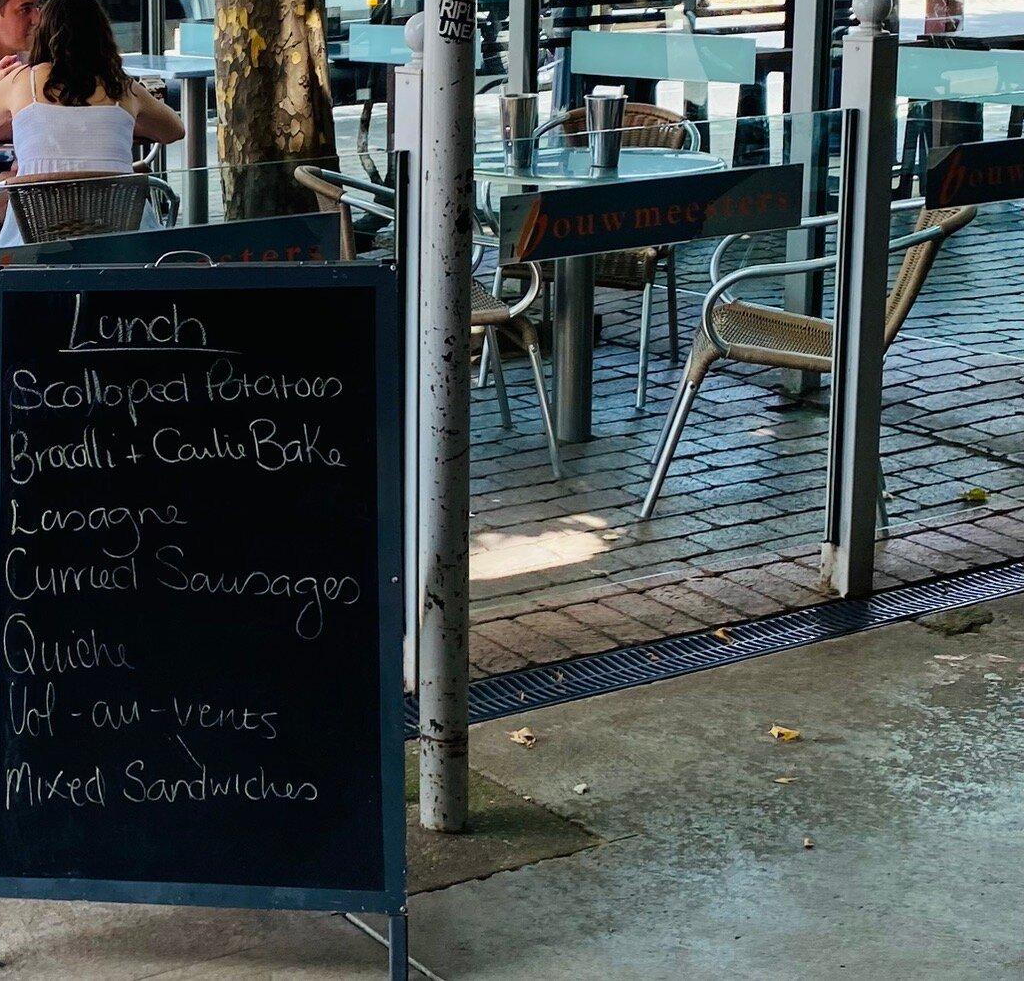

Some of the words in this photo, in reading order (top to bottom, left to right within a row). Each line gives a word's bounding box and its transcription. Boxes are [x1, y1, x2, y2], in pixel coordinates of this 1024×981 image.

[68, 292, 207, 350] Lunch
[125, 443, 144, 464] +
[248, 417, 348, 471] Bake
[9, 498, 188, 559] Lasagne
[4, 546, 138, 601] Curried
[155, 544, 362, 640] Sausages
[2, 612, 136, 676] Quiche
[5, 761, 107, 811] Mixed
[123, 759, 320, 804] Sandwiches
